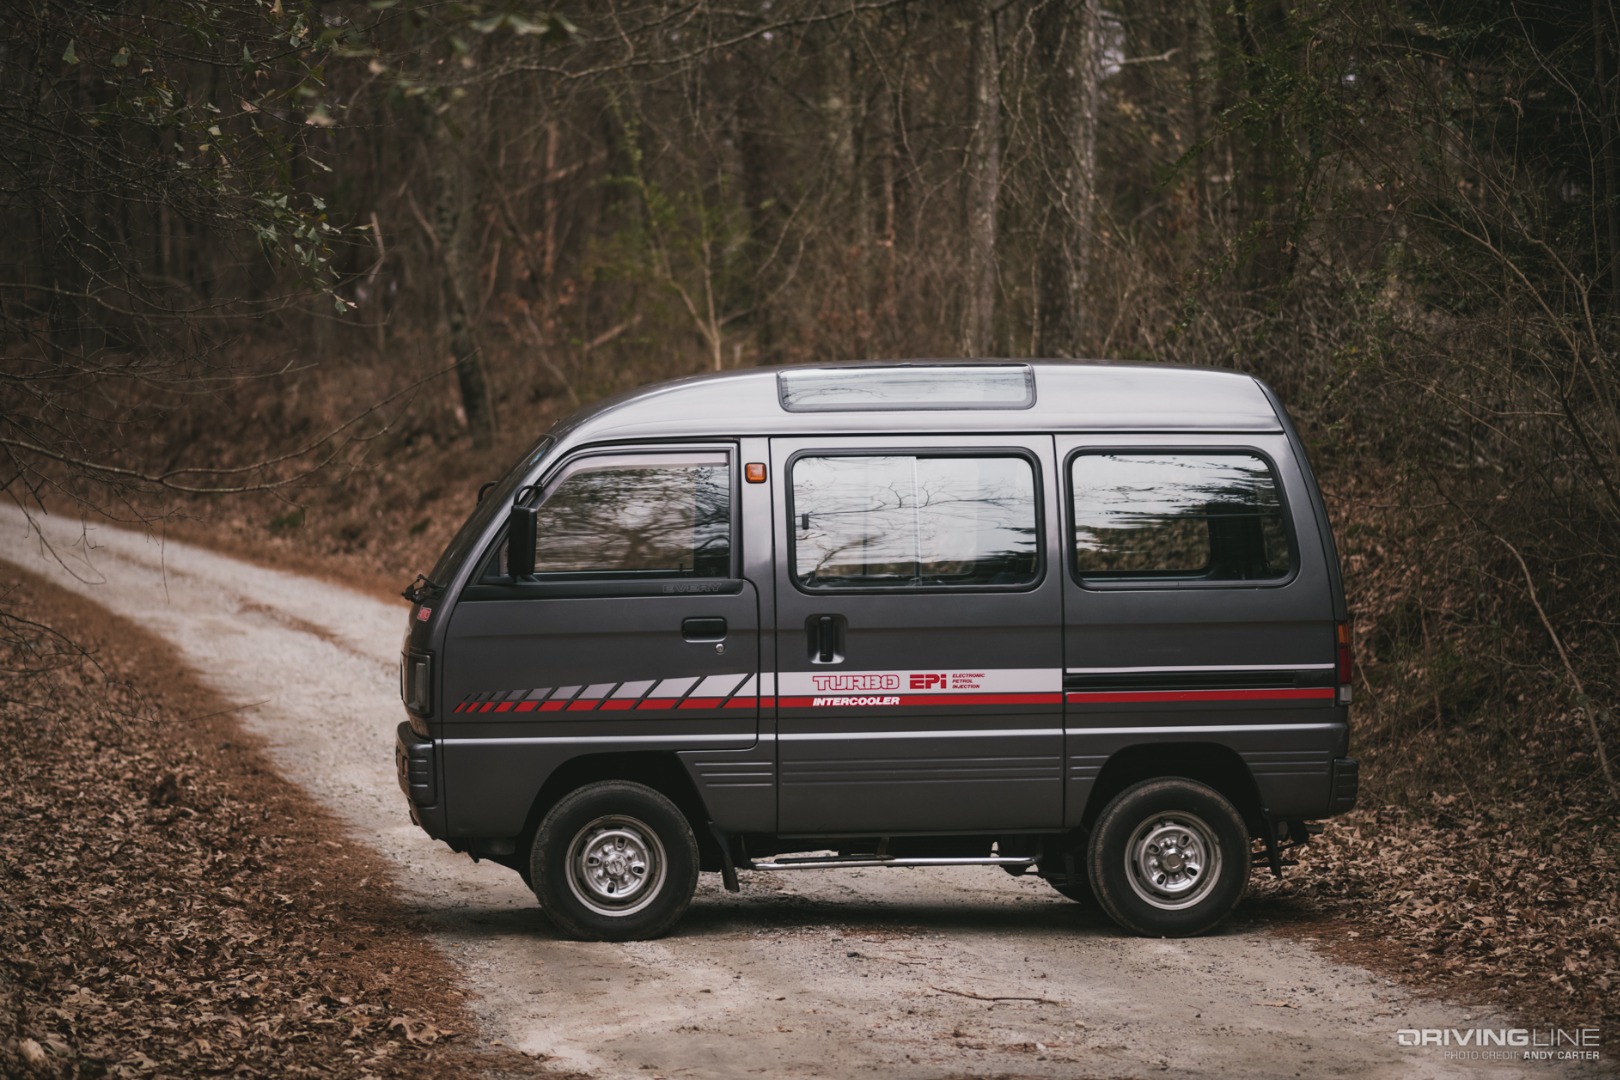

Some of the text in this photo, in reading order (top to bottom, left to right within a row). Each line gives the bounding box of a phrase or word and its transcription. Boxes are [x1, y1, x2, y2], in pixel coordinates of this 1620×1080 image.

[663, 583, 721, 593] EVERY
[812, 675, 900, 690] TURBO
[812, 697, 900, 706] INTERCOOLER
